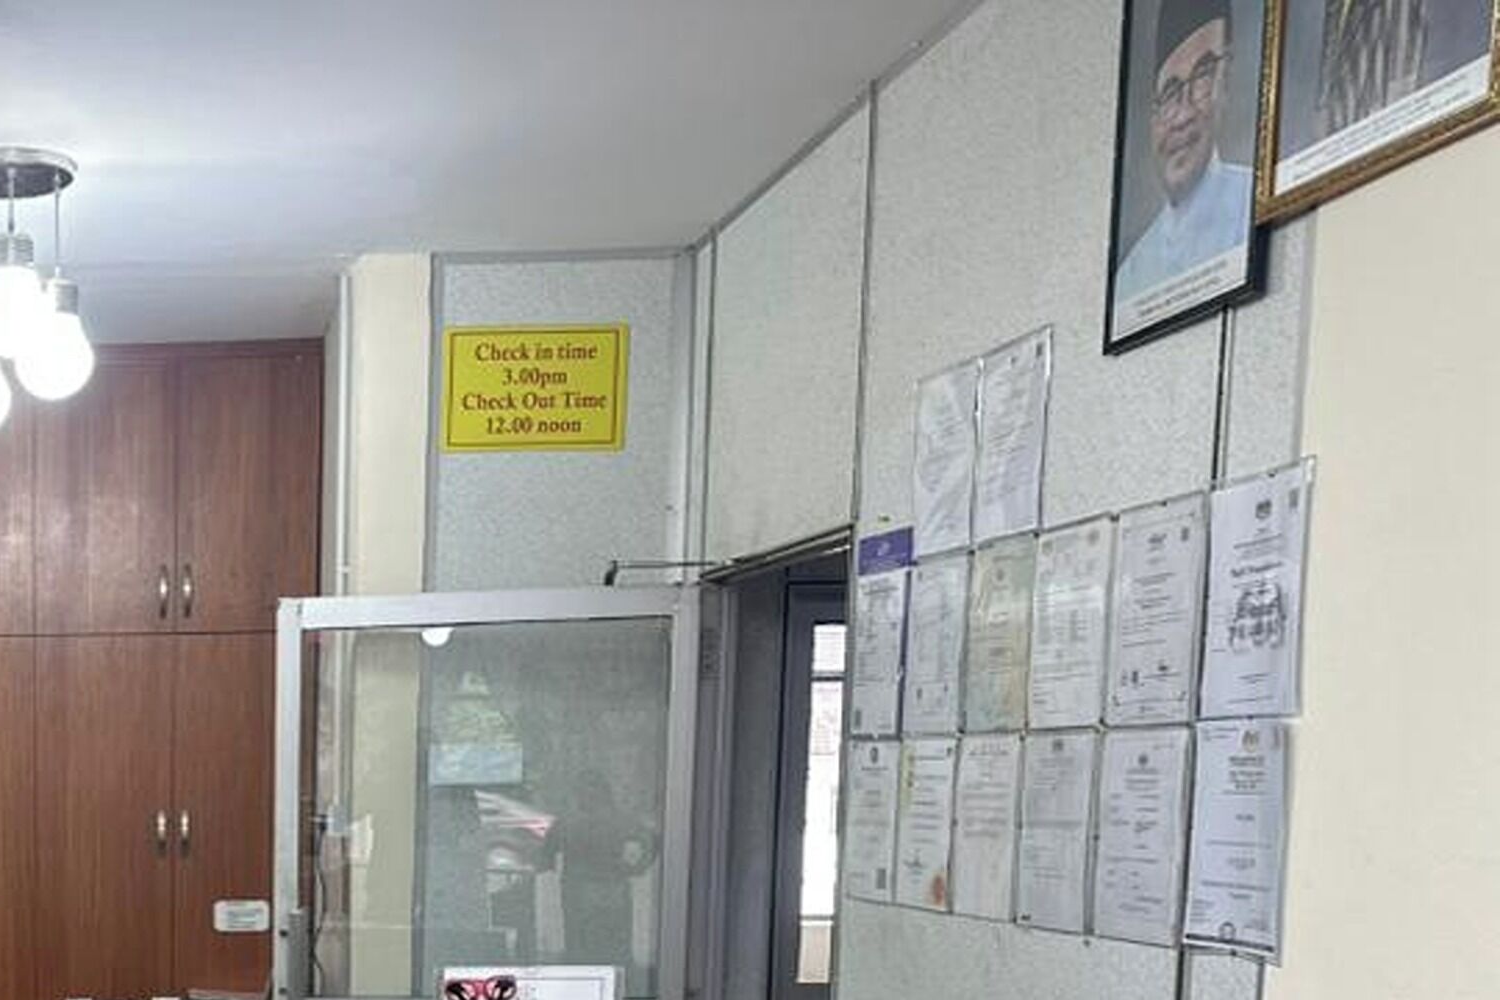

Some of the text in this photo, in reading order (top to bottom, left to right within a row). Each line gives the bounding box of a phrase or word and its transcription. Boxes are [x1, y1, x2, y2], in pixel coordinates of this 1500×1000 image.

[475, 343, 597, 362] Check in time
[502, 367, 568, 389] 3.00pm
[462, 392, 606, 411] Check Out Time
[486, 417, 582, 435] 12.00 noon
